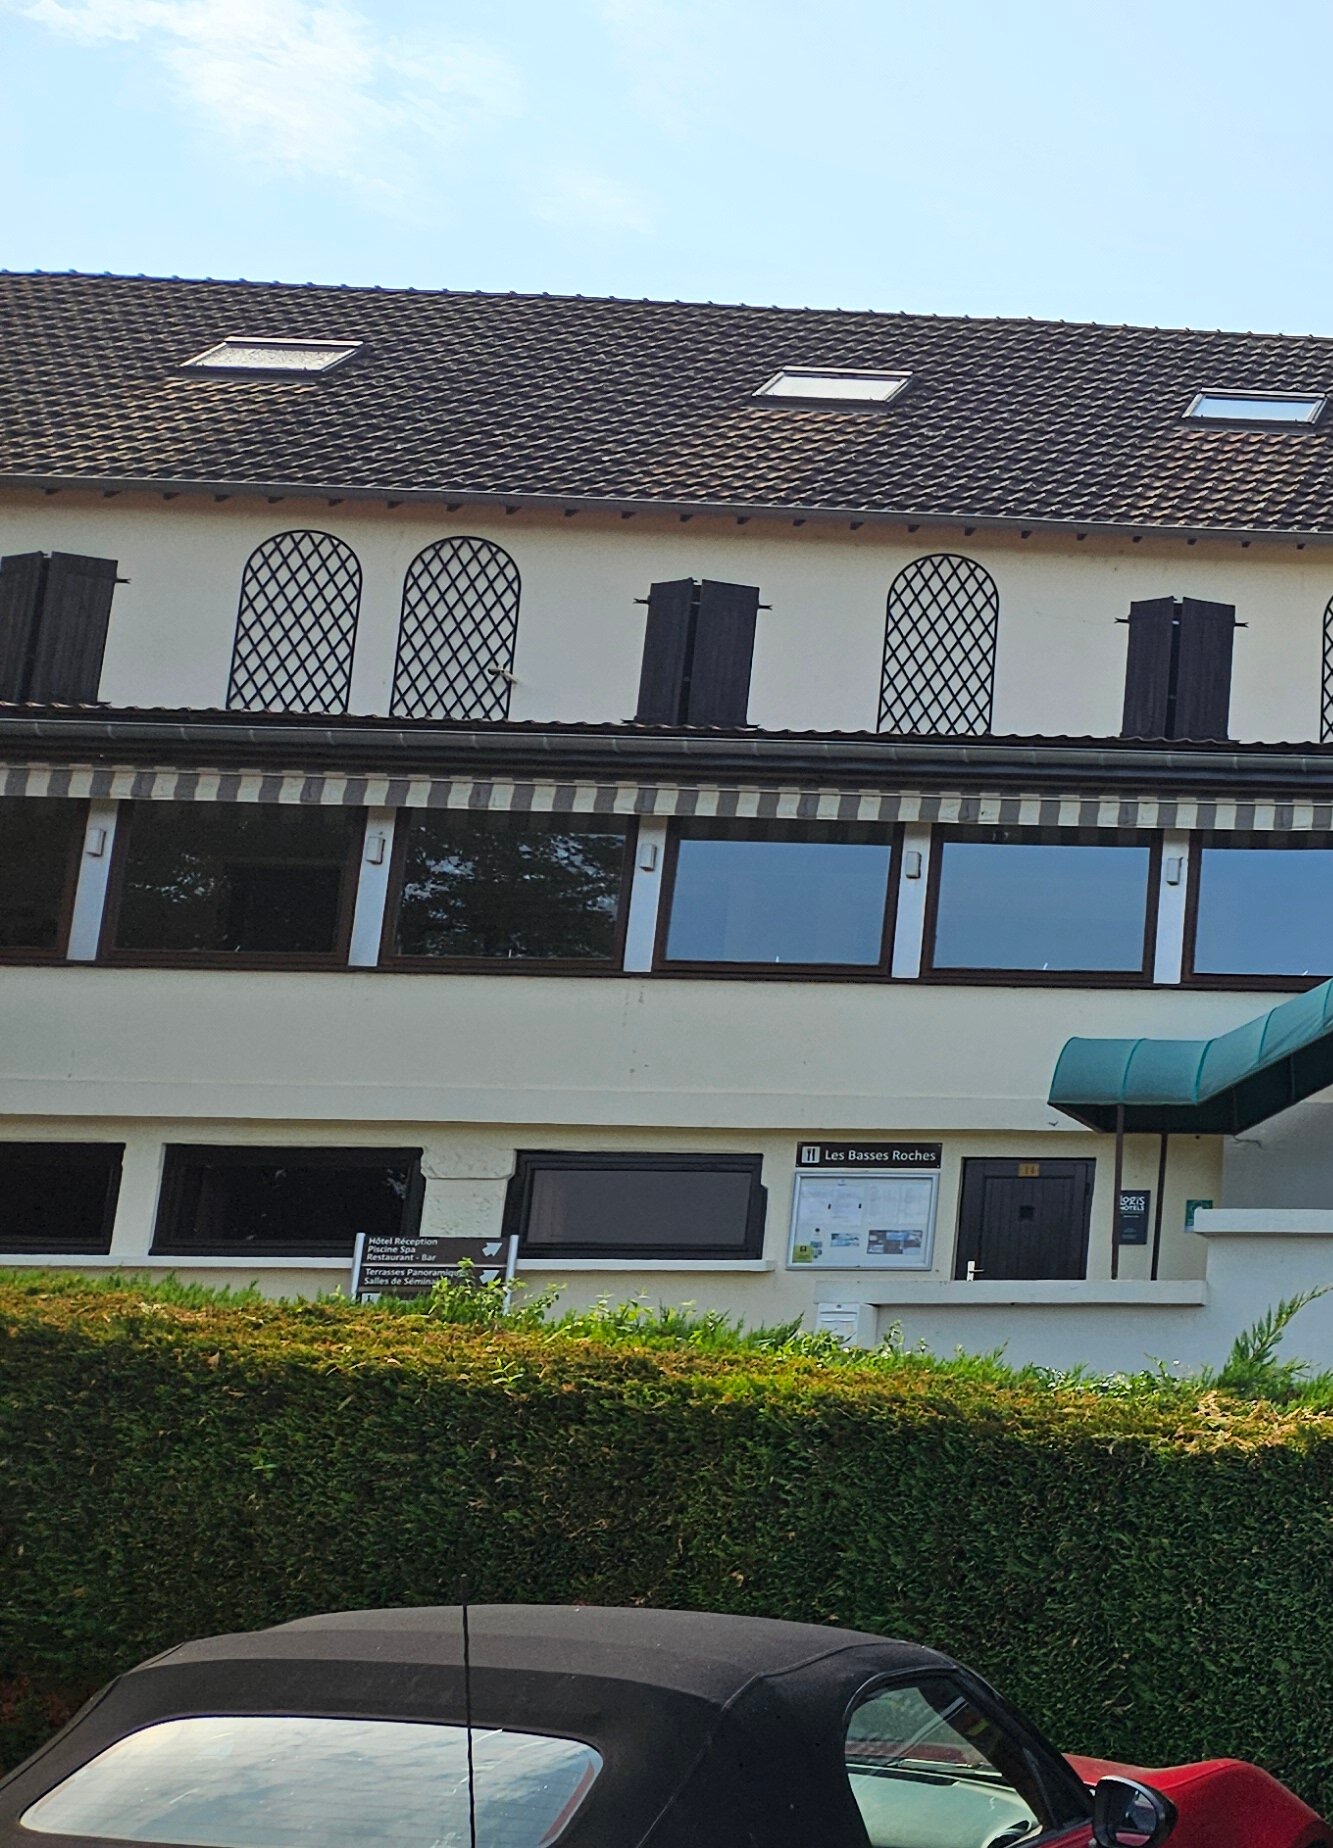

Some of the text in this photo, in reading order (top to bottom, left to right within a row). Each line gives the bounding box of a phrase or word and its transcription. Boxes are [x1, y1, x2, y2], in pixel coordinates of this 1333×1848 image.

[825, 1149, 936, 1161] Les Basses Roches
[368, 1237, 438, 1247] Hôtel Réception
[367, 1245, 416, 1254] Piscine Spa
[366, 1253, 414, 1261] Restaurant
[421, 1254, 437, 1262] Bar
[366, 1268, 406, 1276] Terrasses
[364, 1277, 389, 1285] Salles
[391, 1277, 402, 1285] de
